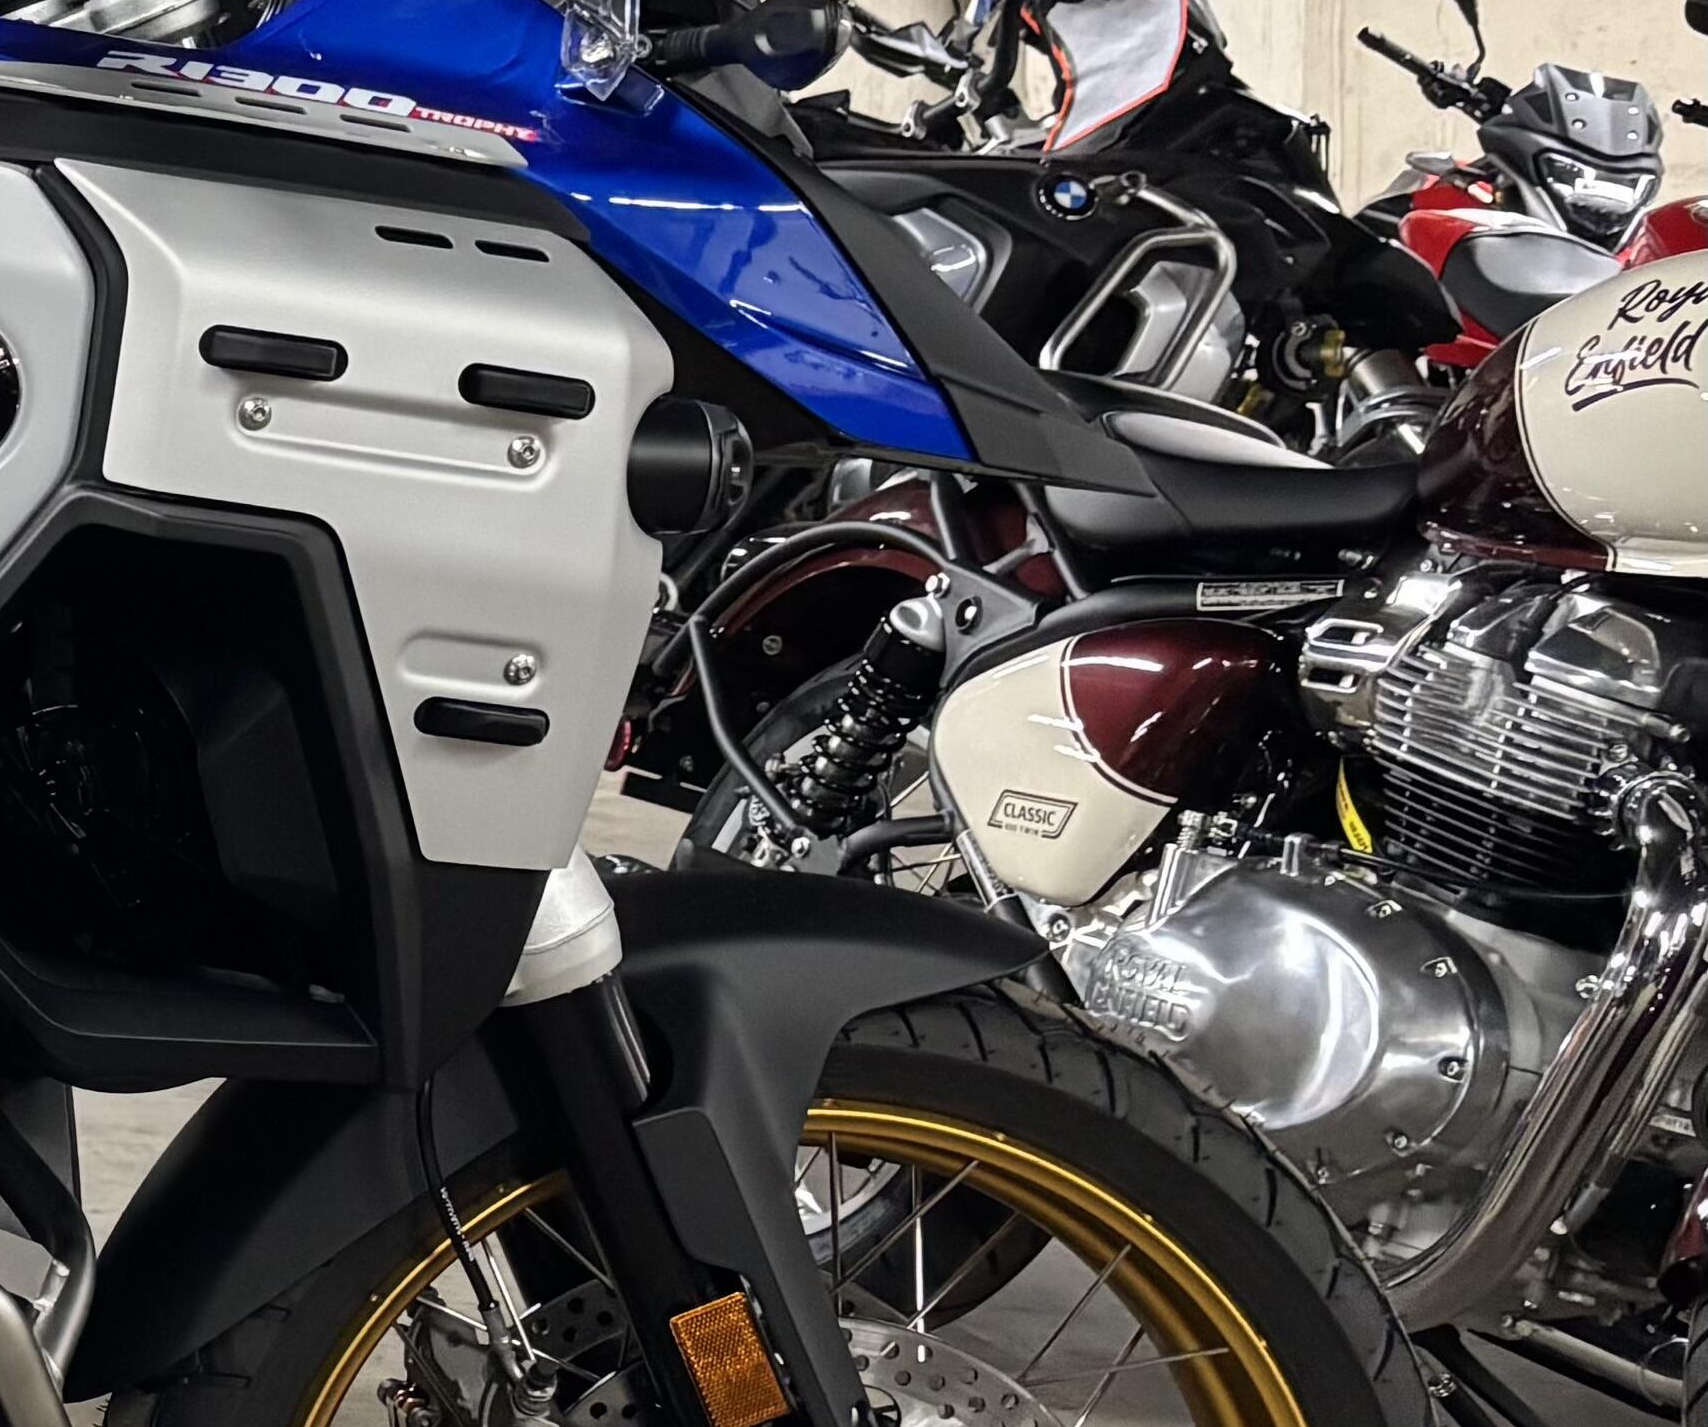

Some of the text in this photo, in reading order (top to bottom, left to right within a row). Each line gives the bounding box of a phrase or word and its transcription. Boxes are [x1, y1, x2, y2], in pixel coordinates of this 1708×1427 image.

[96, 50, 539, 142] R1300 TROPHY
[1564, 320, 1708, 397] Enfield
[1004, 802, 1057, 827] CLASSIC
